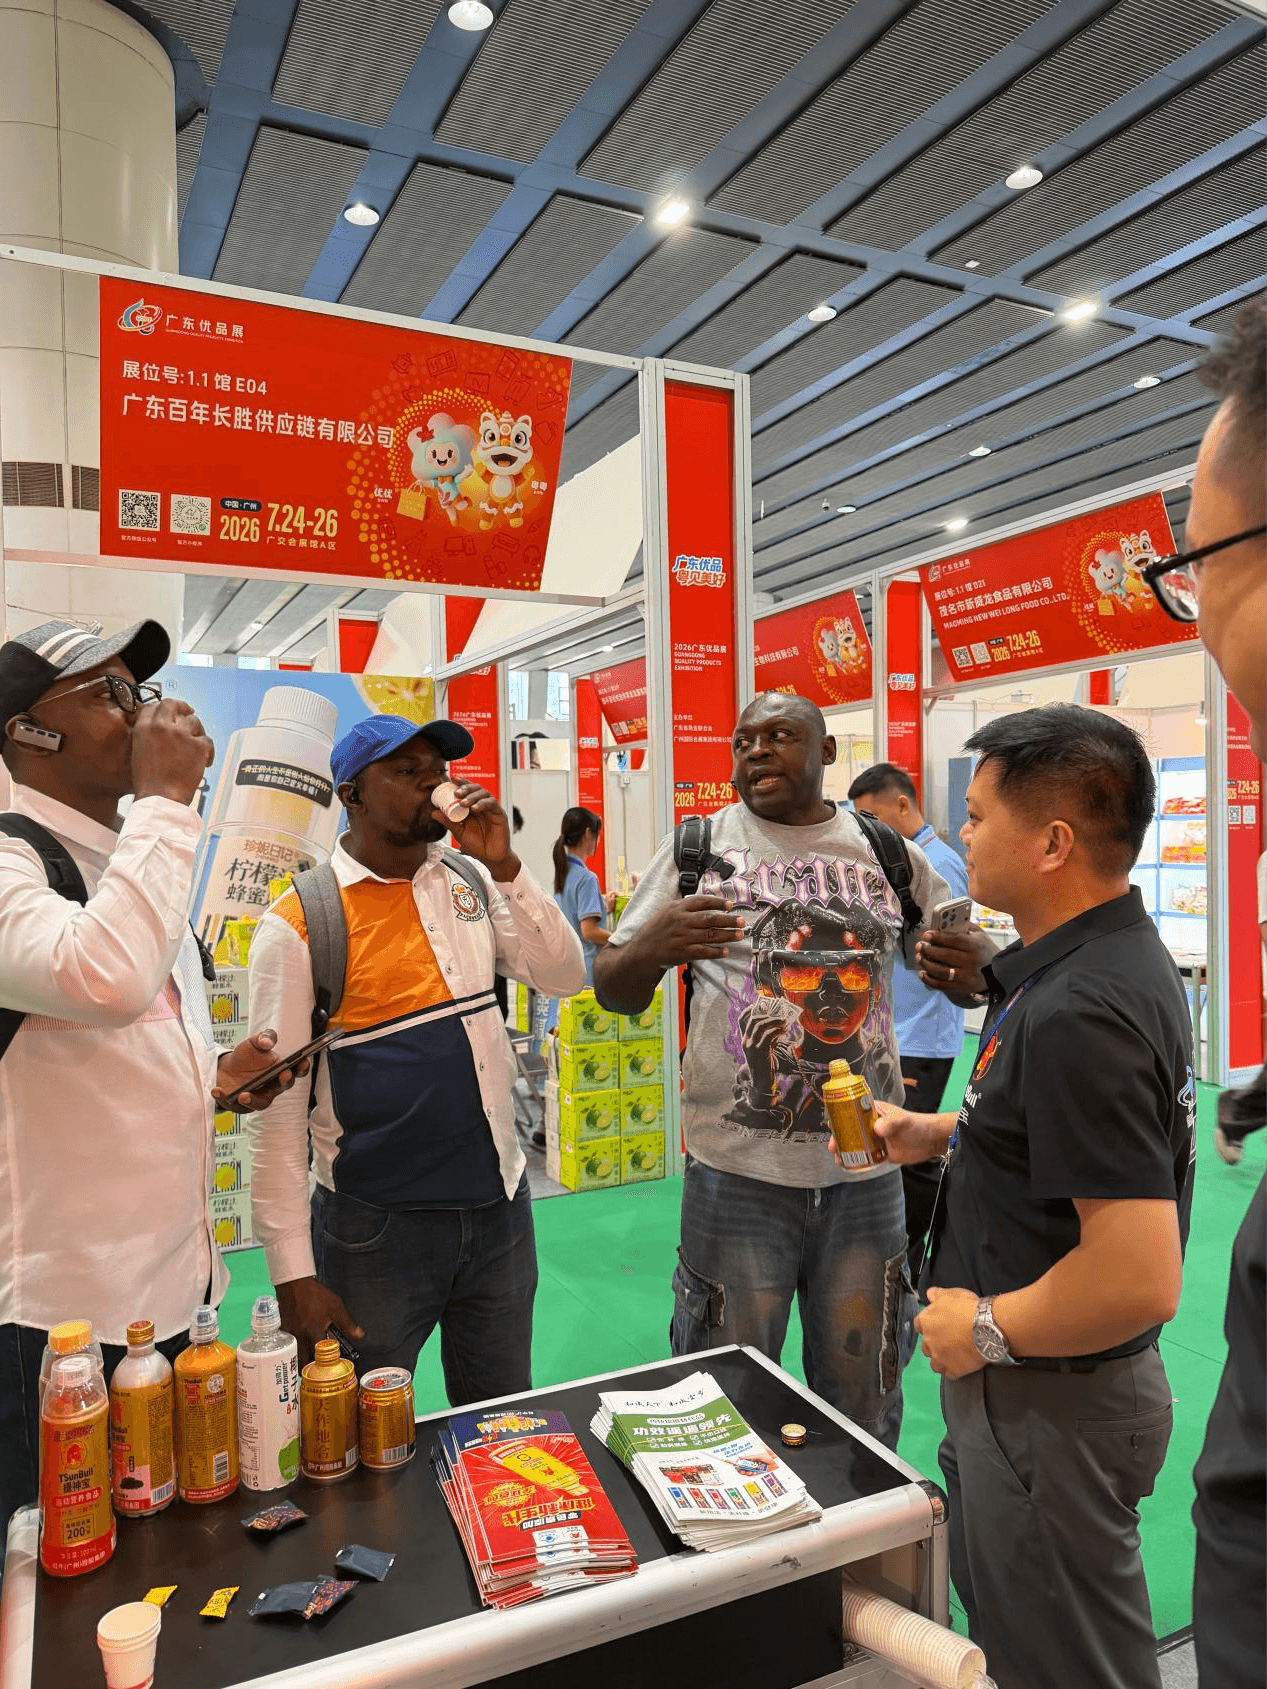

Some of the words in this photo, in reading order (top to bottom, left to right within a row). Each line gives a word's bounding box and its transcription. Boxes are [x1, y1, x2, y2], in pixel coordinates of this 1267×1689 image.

[166, 314, 244, 338] 广东优品展
[122, 360, 208, 387] 展位号:1.1
[214, 372, 232, 392] 馆
[236, 378, 268, 396] E04
[122, 393, 394, 448] 广东百年长胜供应链有限公司
[224, 500, 257, 510] 中国·广州
[220, 515, 260, 543] 2026
[267, 502, 338, 538] 7.24-26
[266, 536, 337, 550] 广交会展馆A区
[672, 555, 722, 572] 广东优品
[938, 576, 1053, 618] 茂名市新威龙食品有限公司
[944, 616, 974, 630] MAOMING
[973, 612, 988, 623] NEW
[989, 609, 1001, 619] WEI
[1001, 604, 1020, 616] LONG
[1020, 599, 1040, 610] FOOD
[674, 643, 727, 654] 2026广东优品展
[1006, 630, 1041, 651] 7.24-26
[992, 646, 1010, 662] 2026
[674, 792, 695, 807] 2026
[696, 782, 732, 800] 7.24-26
[632, 1414, 731, 1436] 功效遥遥领先
[59, 1466, 94, 1482] TSunBull
[63, 1478, 91, 1493] 提神宝
[55, 1488, 100, 1507] 运动营养食品
[67, 1526, 86, 1540] 200
